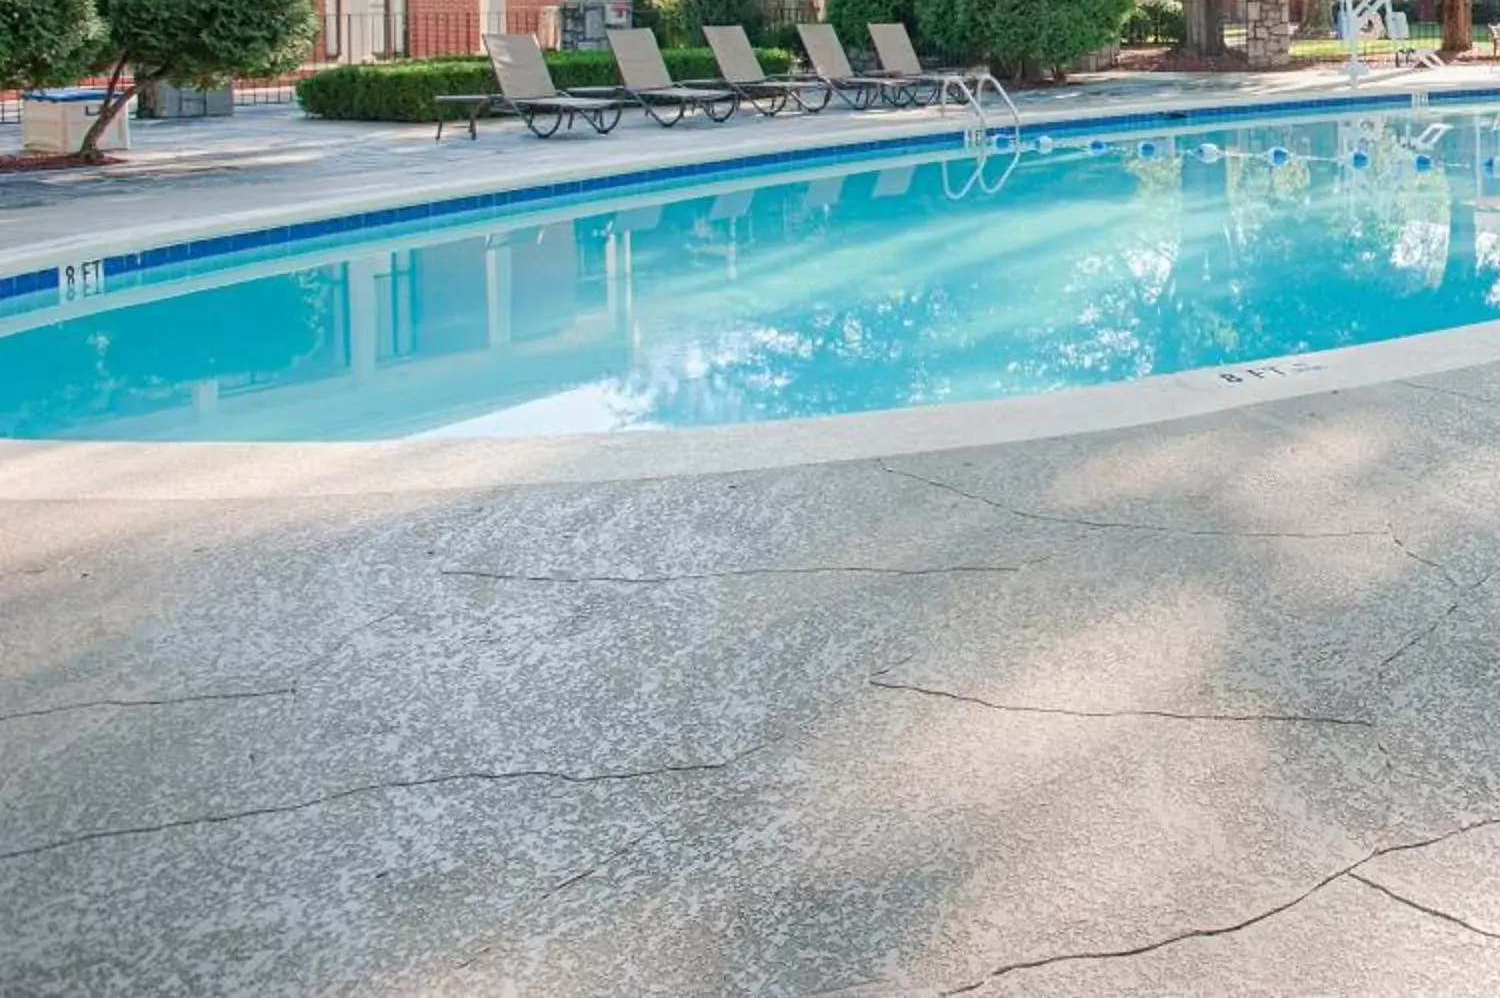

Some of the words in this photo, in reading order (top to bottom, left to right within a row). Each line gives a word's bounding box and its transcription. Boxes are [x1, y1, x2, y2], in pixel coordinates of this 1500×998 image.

[65, 265, 76, 286] 8
[81, 259, 102, 282] FT
[1219, 373, 1243, 383] 8
[1246, 365, 1287, 379] FT
